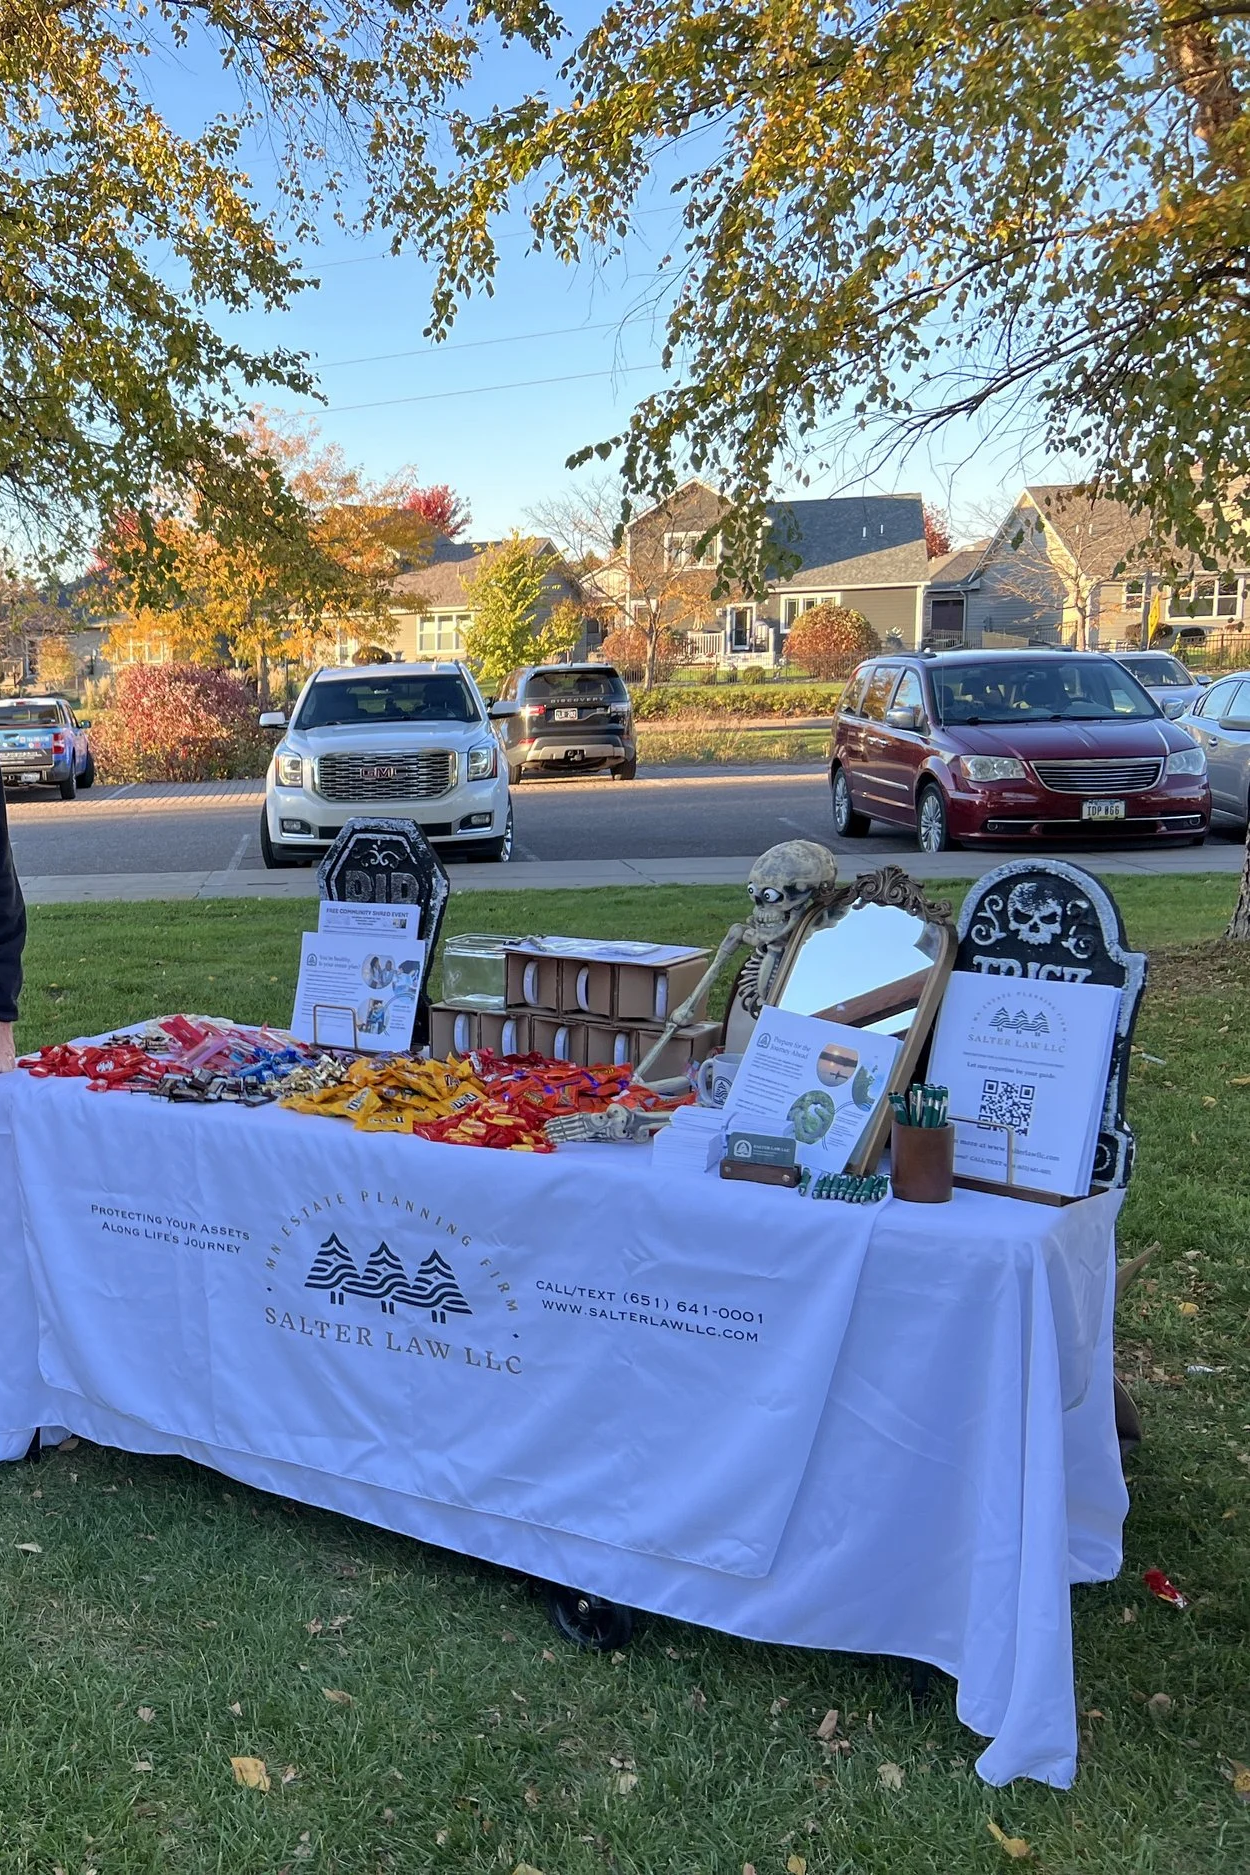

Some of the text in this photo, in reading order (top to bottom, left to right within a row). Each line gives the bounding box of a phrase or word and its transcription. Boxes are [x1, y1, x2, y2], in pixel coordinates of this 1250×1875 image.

[340, 908, 372, 916] COMMUNITY
[968, 1034, 1066, 1053] SALTER LAW LLC
[281, 1193, 346, 1237] ESTATE
[360, 1190, 472, 1247] PLANNING
[480, 1257, 519, 1312] FIRM
[536, 1280, 764, 1324] CALL/TEXT (651) 641-0001
[542, 1299, 759, 1342] WWW.SALTERLAWLLC.COM
[265, 1307, 523, 1375] SALTER LAW LLC
